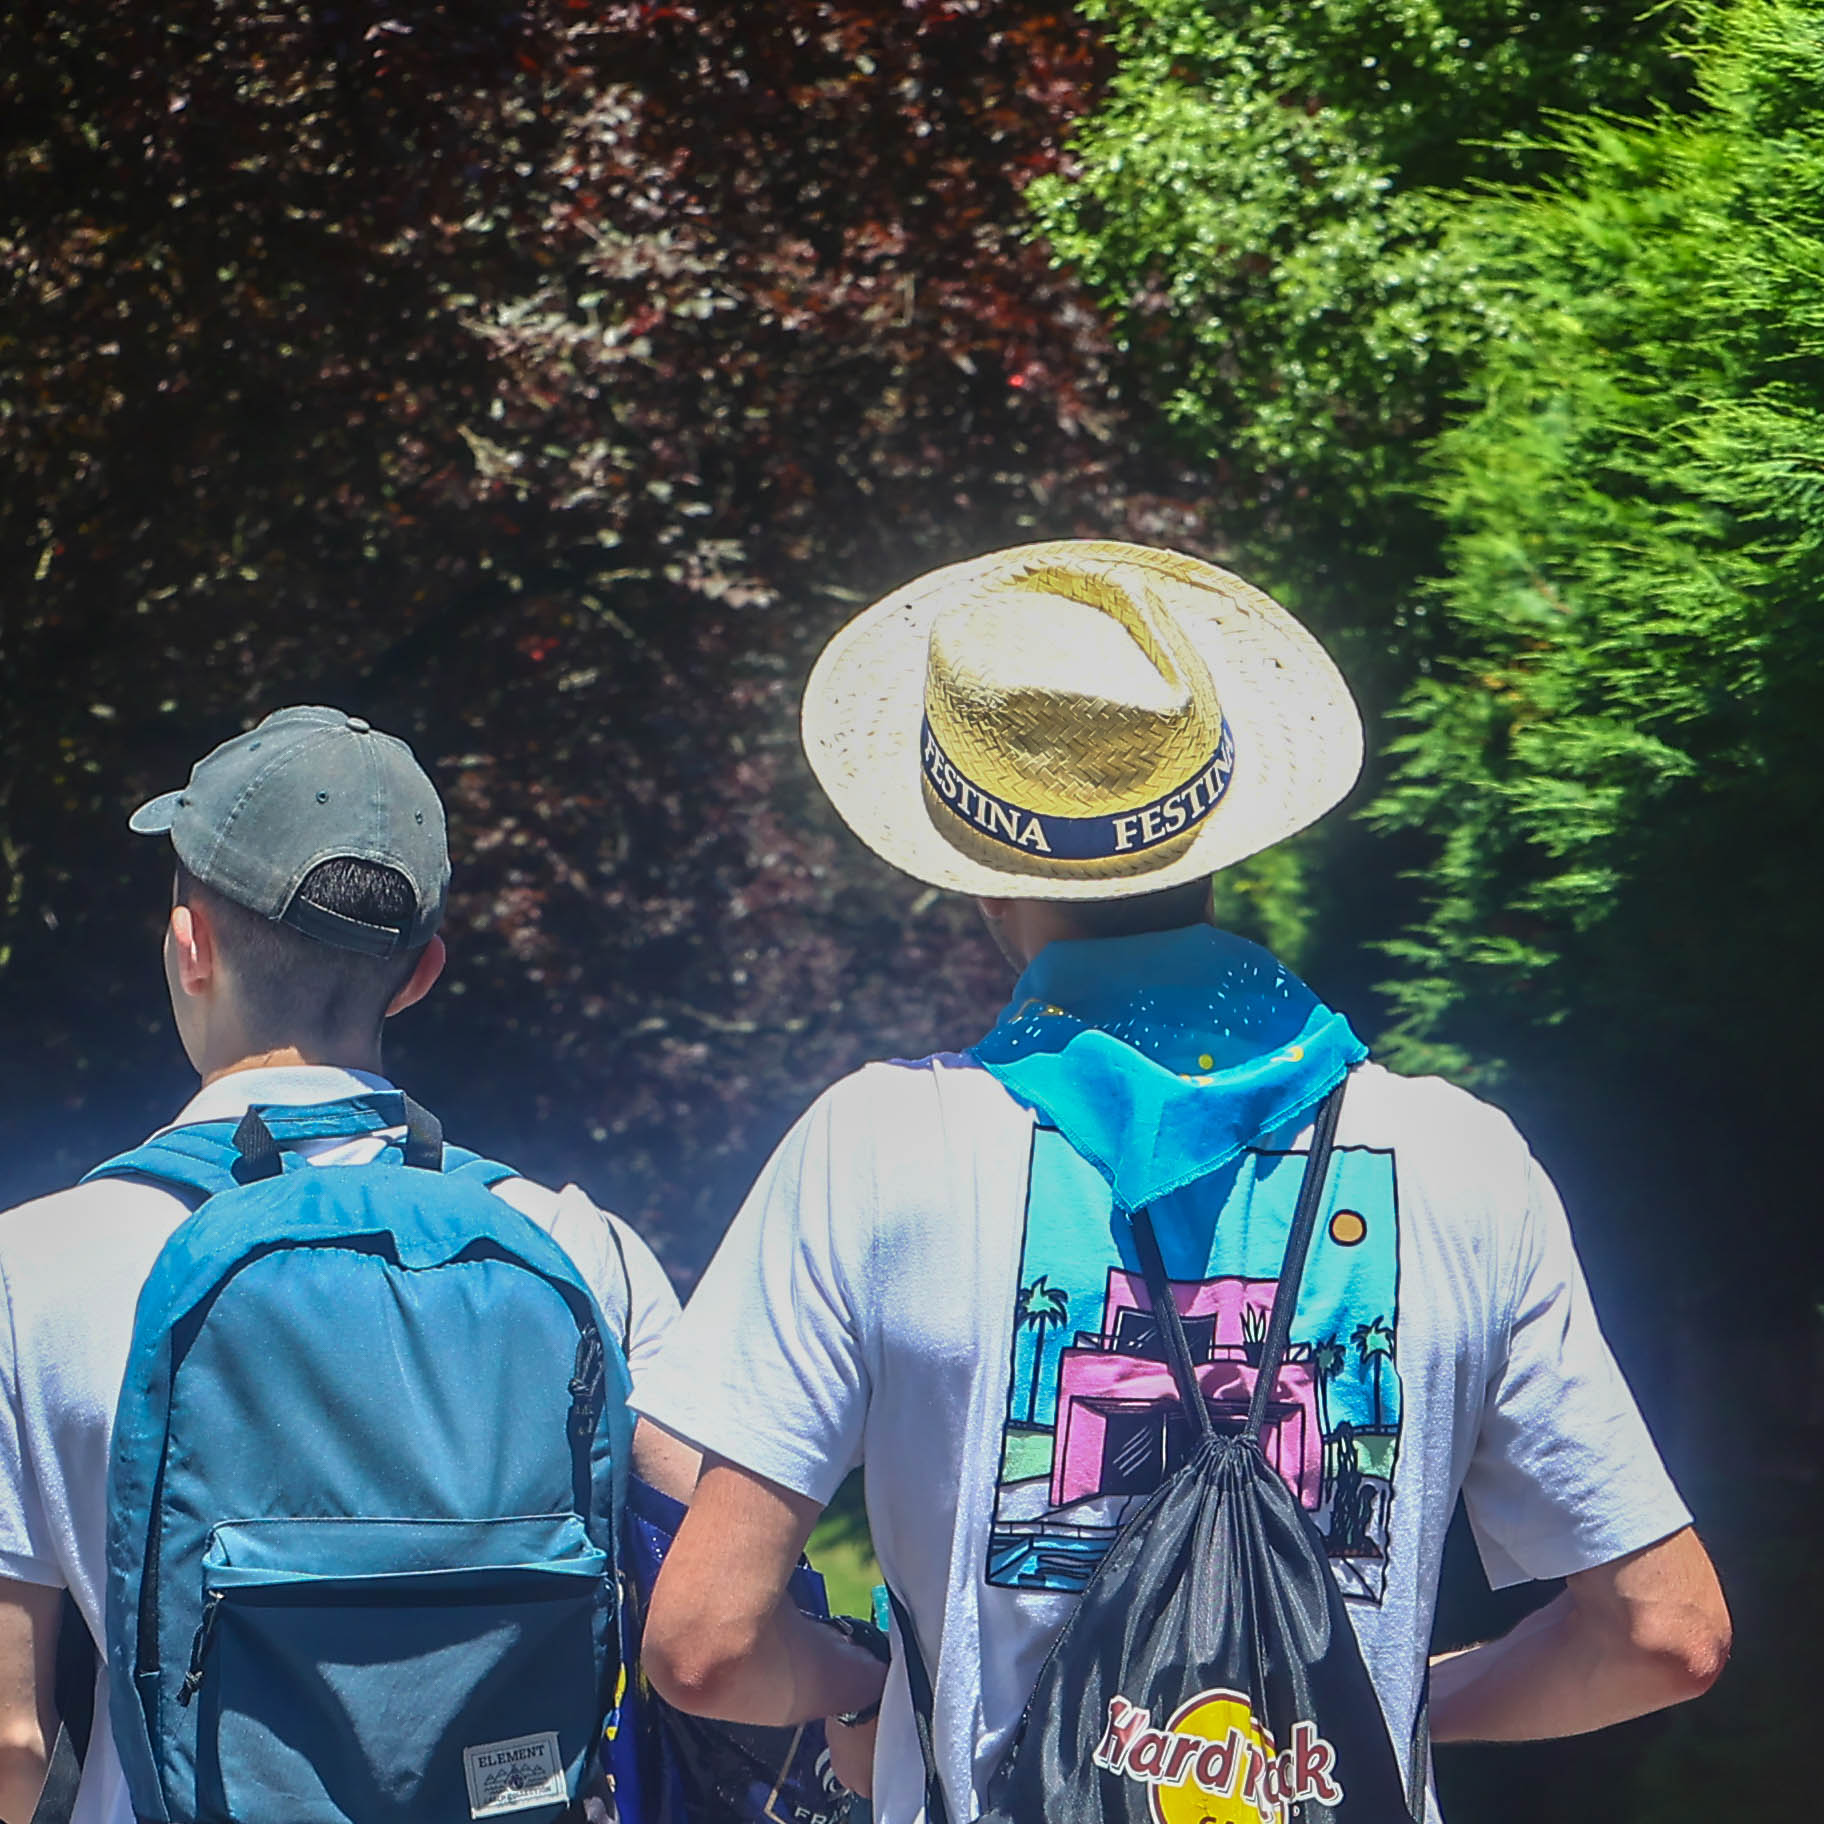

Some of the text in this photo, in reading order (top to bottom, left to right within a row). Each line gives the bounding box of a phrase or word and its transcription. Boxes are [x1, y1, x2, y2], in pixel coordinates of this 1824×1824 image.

[924, 728, 1052, 853] FESTINA
[1112, 728, 1234, 852] FESTINA
[478, 1744, 545, 1769] ELEMENT
[1094, 1697, 1243, 1795] Hard
